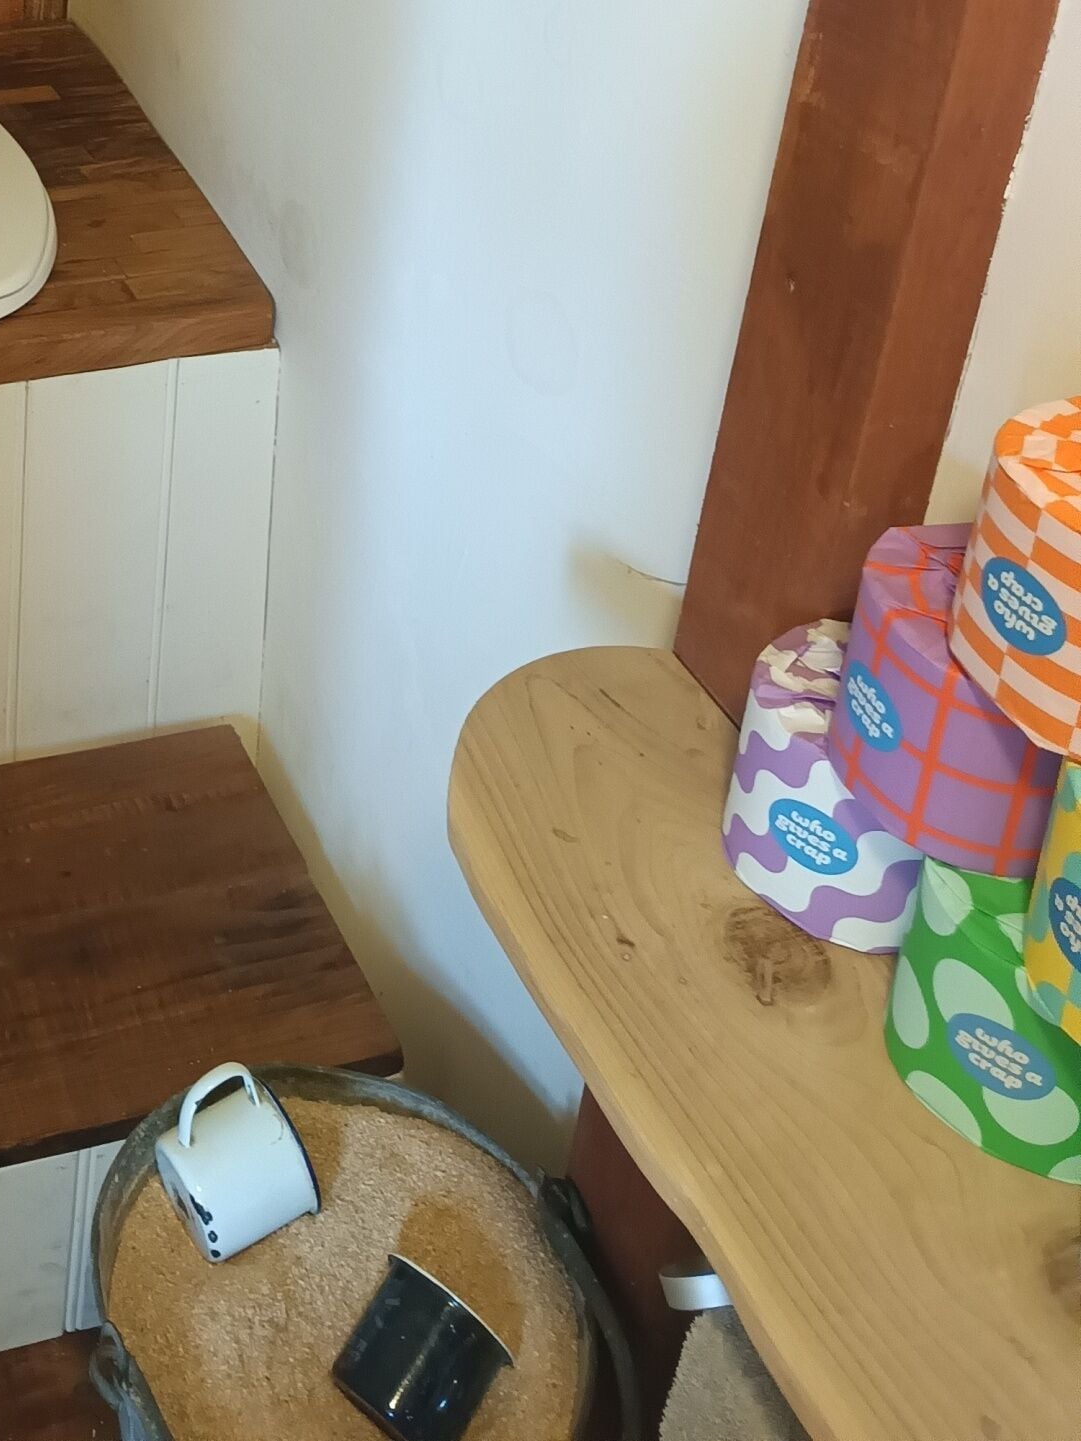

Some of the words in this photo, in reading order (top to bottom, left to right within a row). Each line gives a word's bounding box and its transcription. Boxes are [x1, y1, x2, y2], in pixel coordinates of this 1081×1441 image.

[987, 573, 999, 591] a
[1000, 570, 1044, 612] crap
[993, 599, 1036, 641] who
[998, 587, 1058, 636] gives
[847, 676, 882, 725] gives
[881, 721, 894, 739] a
[856, 674, 886, 714] who
[851, 698, 880, 738] crap
[774, 814, 832, 852] gives
[832, 847, 848, 862] a
[790, 810, 837, 842] who
[786, 833, 832, 866] crap
[954, 1029, 1023, 1075] gives
[1024, 1071, 1043, 1087] a
[975, 1028, 1030, 1065] who
[968, 1052, 1023, 1089] crap
